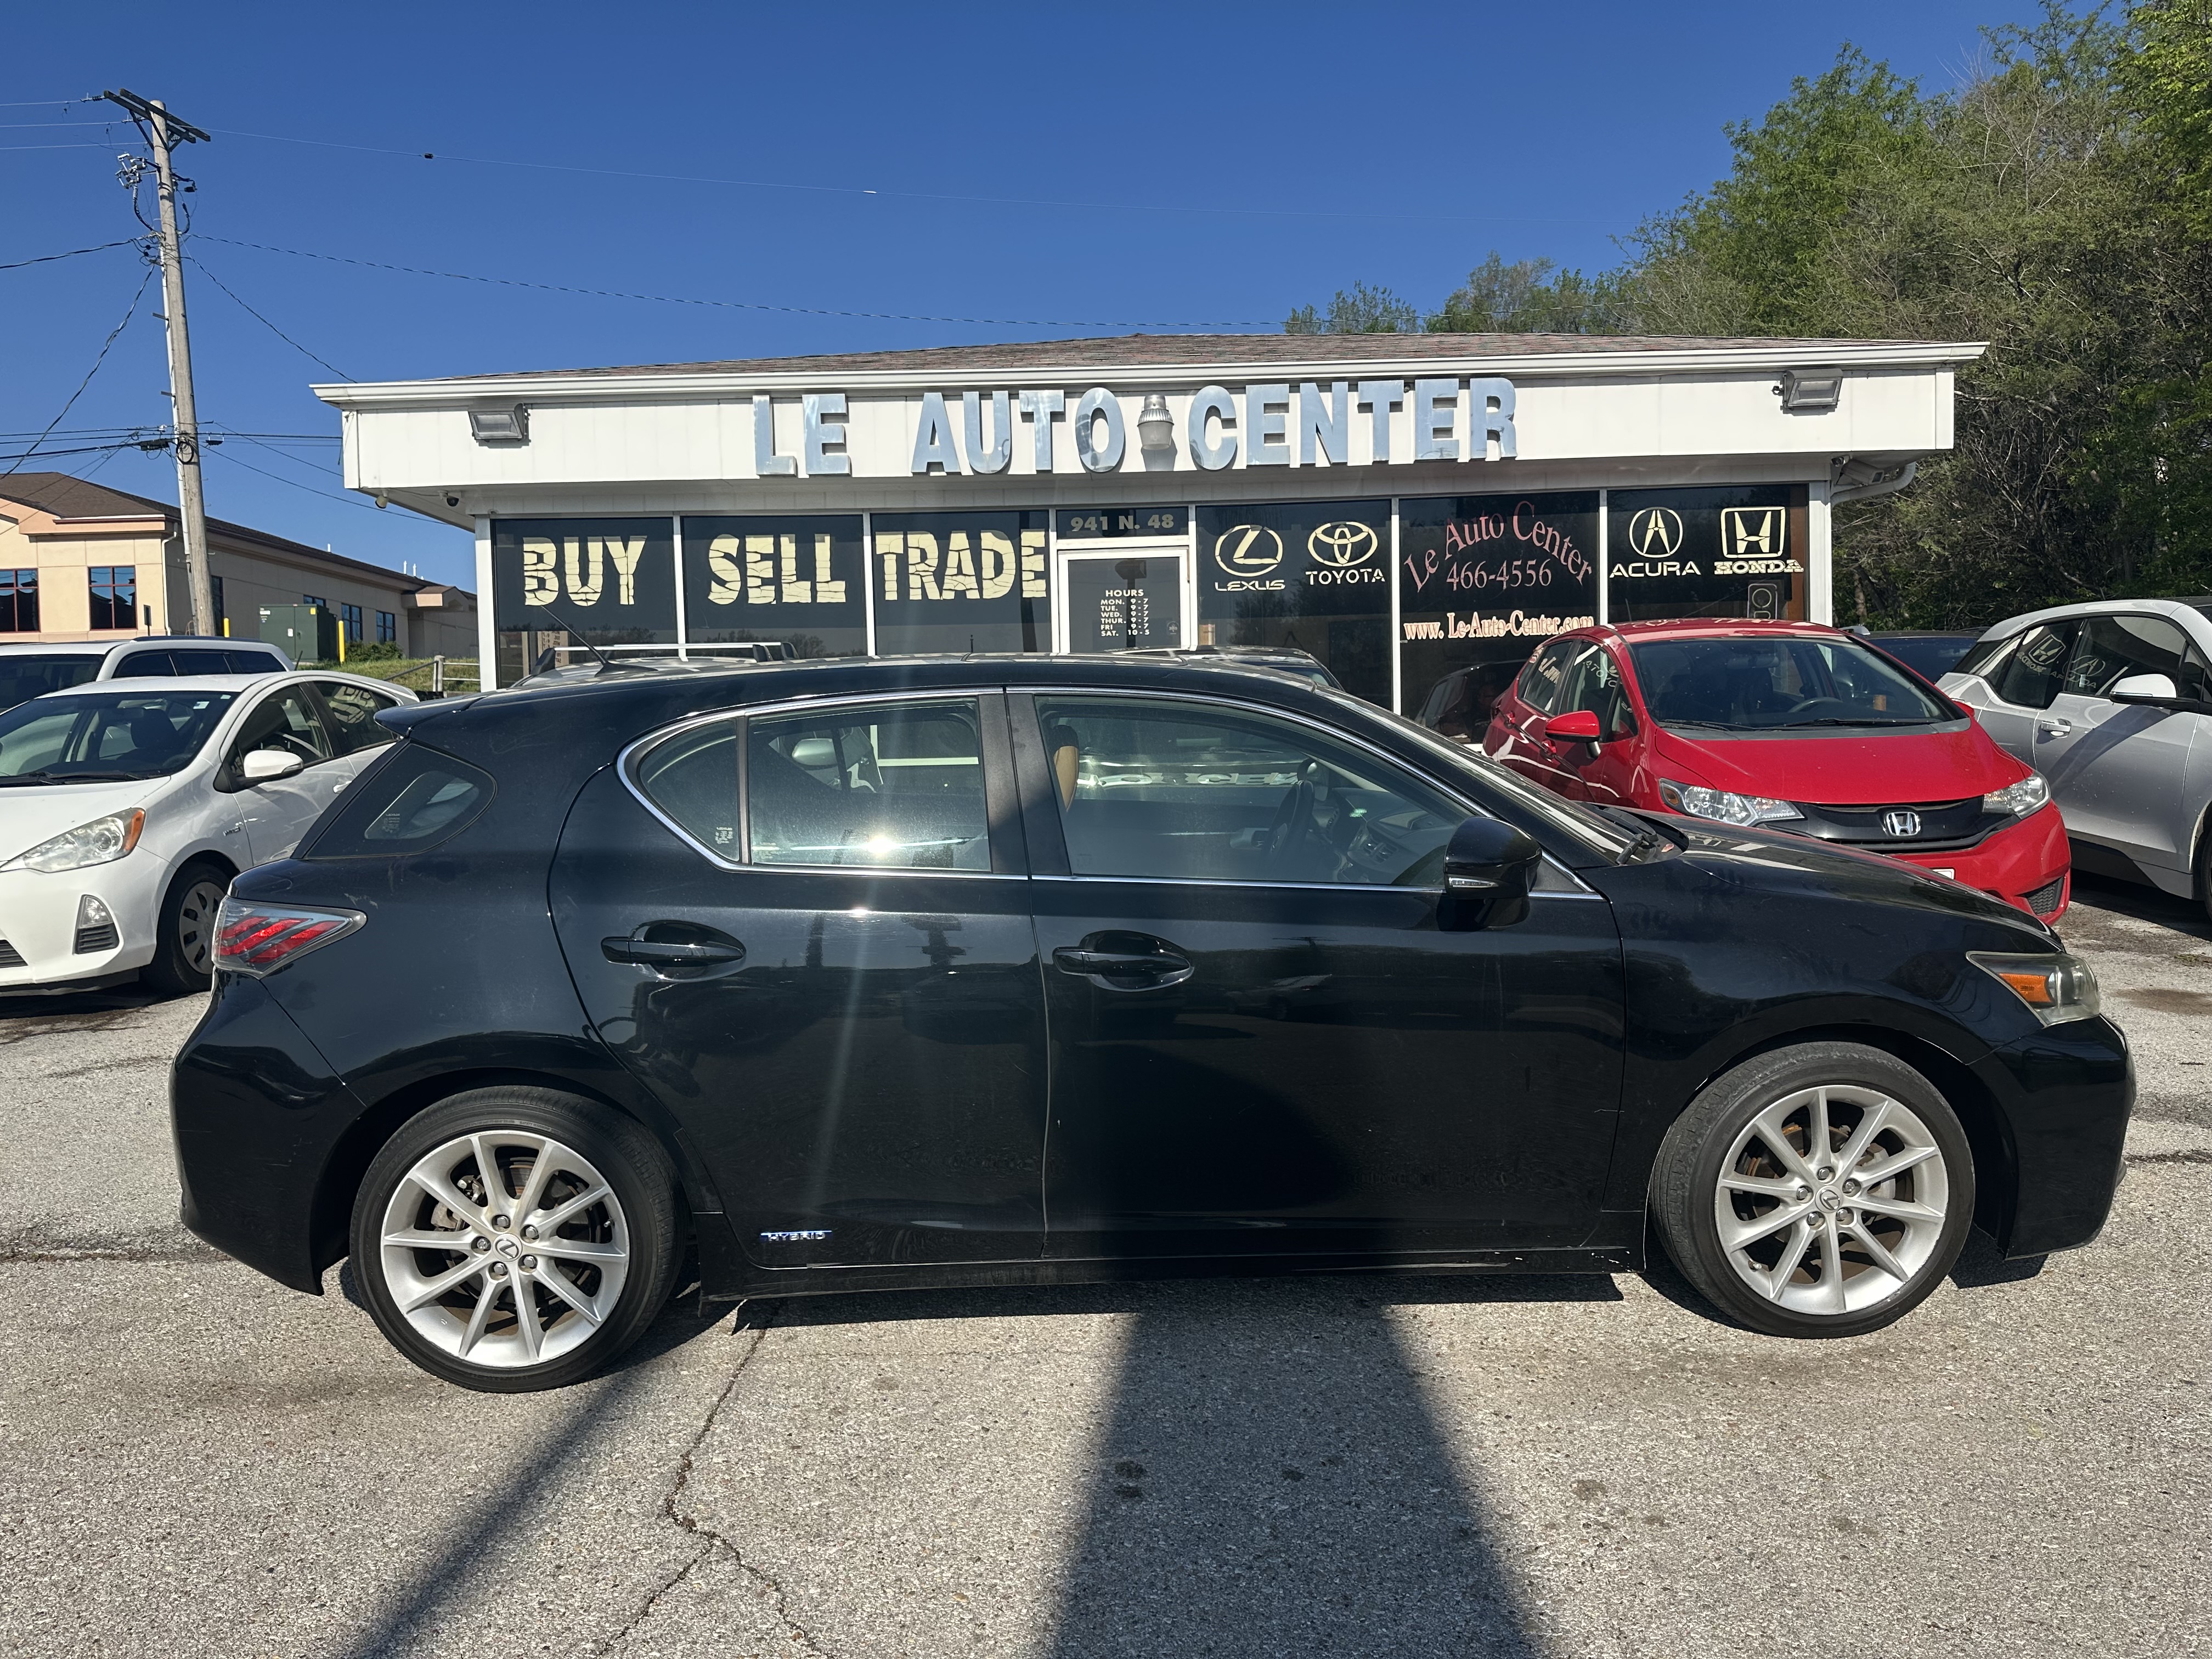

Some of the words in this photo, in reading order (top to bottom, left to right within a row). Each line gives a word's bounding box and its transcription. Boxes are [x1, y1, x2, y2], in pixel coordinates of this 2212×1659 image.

[752, 393, 851, 476] LE
[911, 387, 1125, 475] AUTO
[1188, 377, 1517, 471] CENTER
[1070, 516, 1108, 532] 941
[1119, 515, 1140, 530] N.
[1148, 514, 1174, 529] 48
[1403, 549, 1440, 593] Le
[1444, 510, 1505, 561] Auto
[1513, 500, 1593, 587] Center
[523, 535, 647, 607] BUY
[708, 534, 846, 606] SELL
[874, 528, 1047, 601] TRADE
[1609, 561, 1701, 578] ACURA
[1714, 559, 1804, 575] HONDA
[1305, 568, 1386, 585] TOYOTA
[1446, 558, 1552, 591] 466-4556
[1105, 589, 1144, 597] HOURS
[1214, 579, 1286, 592] LEXUS
[768, 1232, 826, 1242] HYBRID
